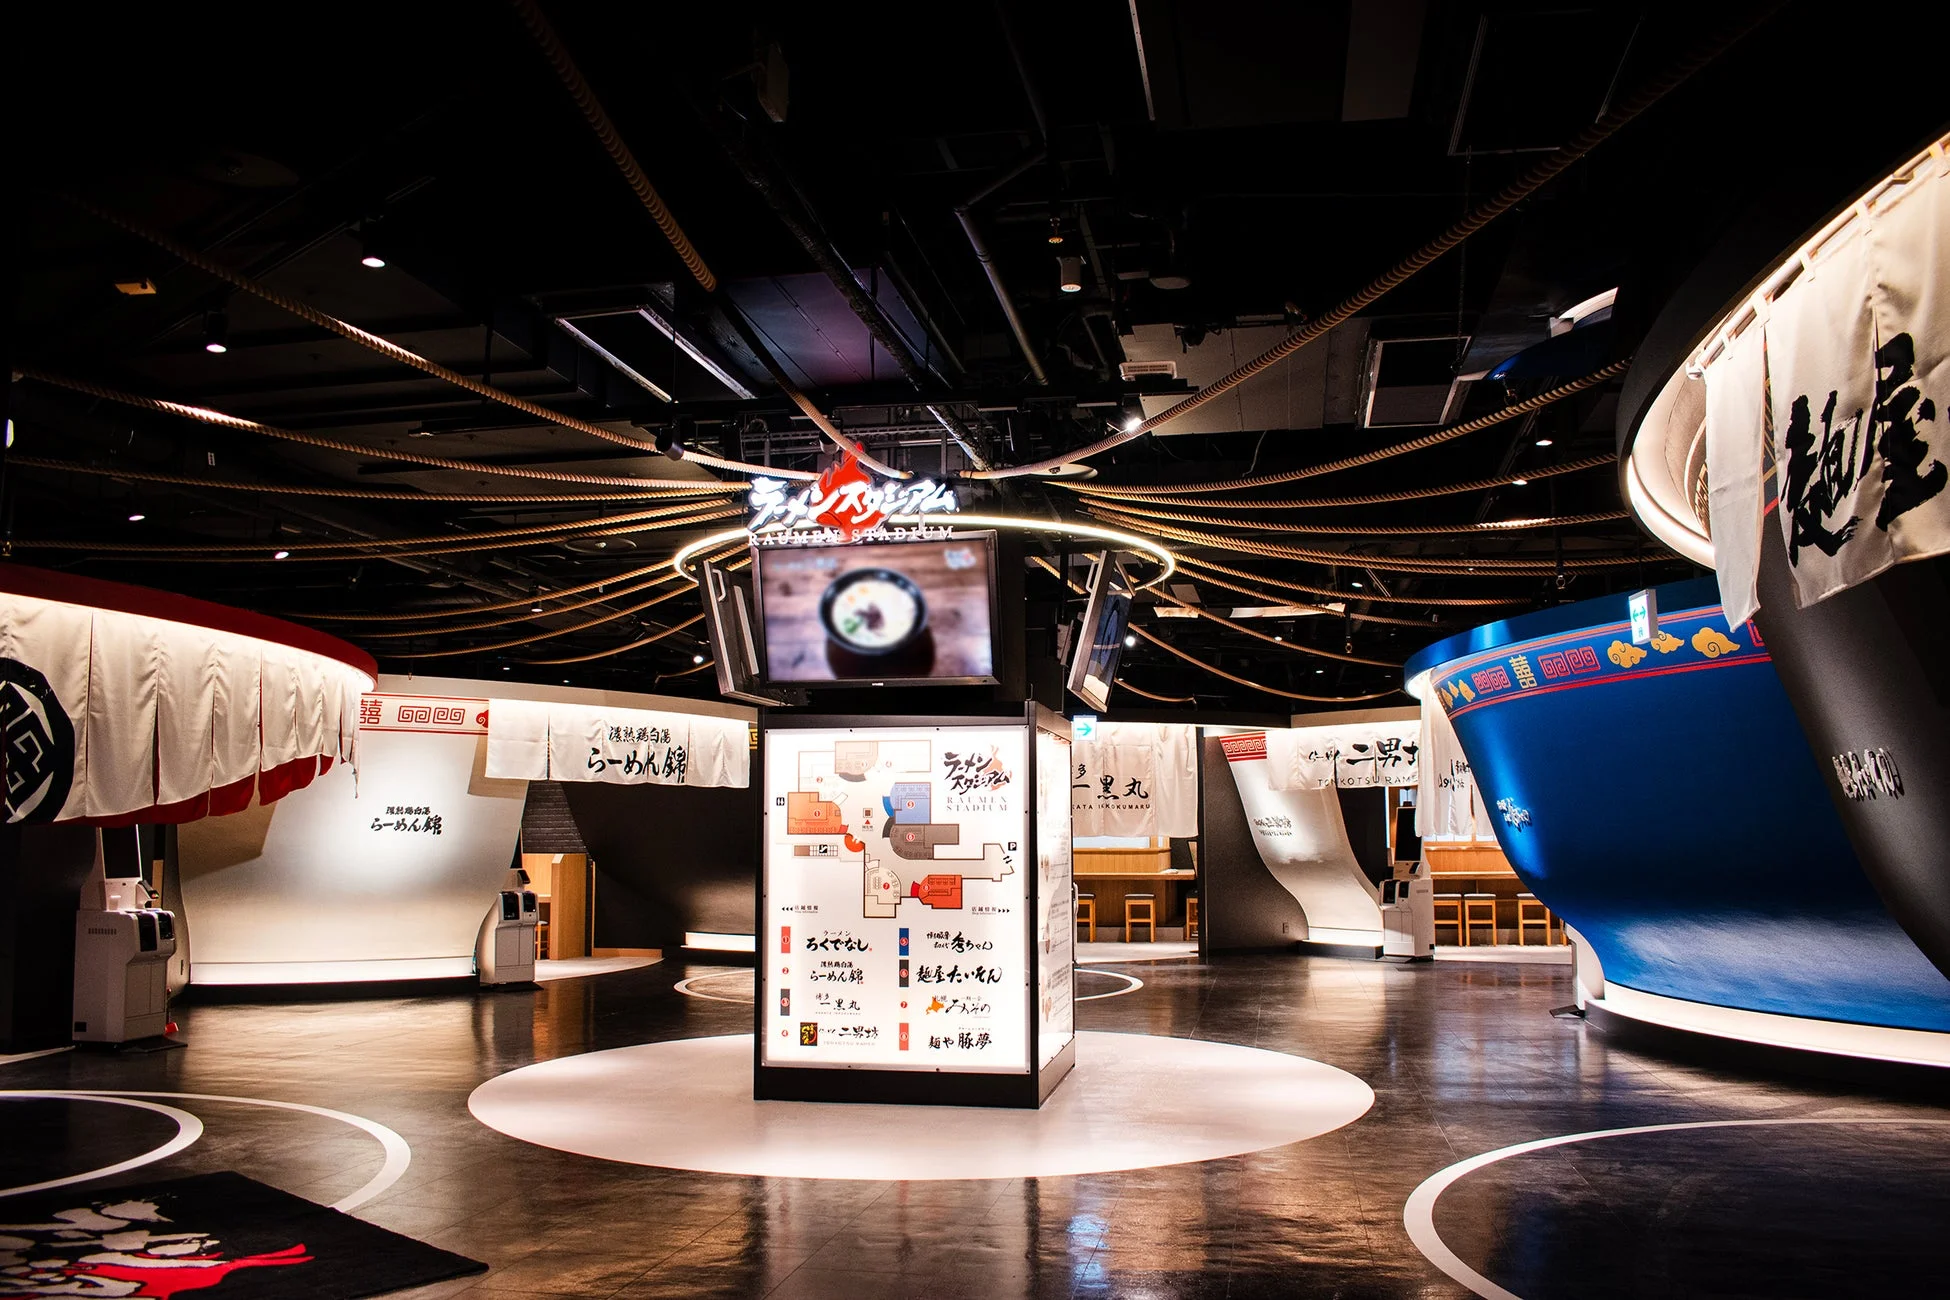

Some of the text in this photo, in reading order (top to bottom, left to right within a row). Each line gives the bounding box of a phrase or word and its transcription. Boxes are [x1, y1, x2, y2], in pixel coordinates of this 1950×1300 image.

[748, 477, 959, 532] ラーメンスタジアム
[748, 526, 954, 546] RAUMEN STADIUM
[588, 745, 686, 783] らーめん錦
[943, 752, 993, 780] ラーメン
[1318, 776, 1380, 787] TONKOTSU
[371, 815, 442, 835] らーめん錦
[806, 937, 869, 952] ろくでなし
[810, 969, 863, 984] らーめん錦
[820, 999, 861, 1010] 一黒丸
